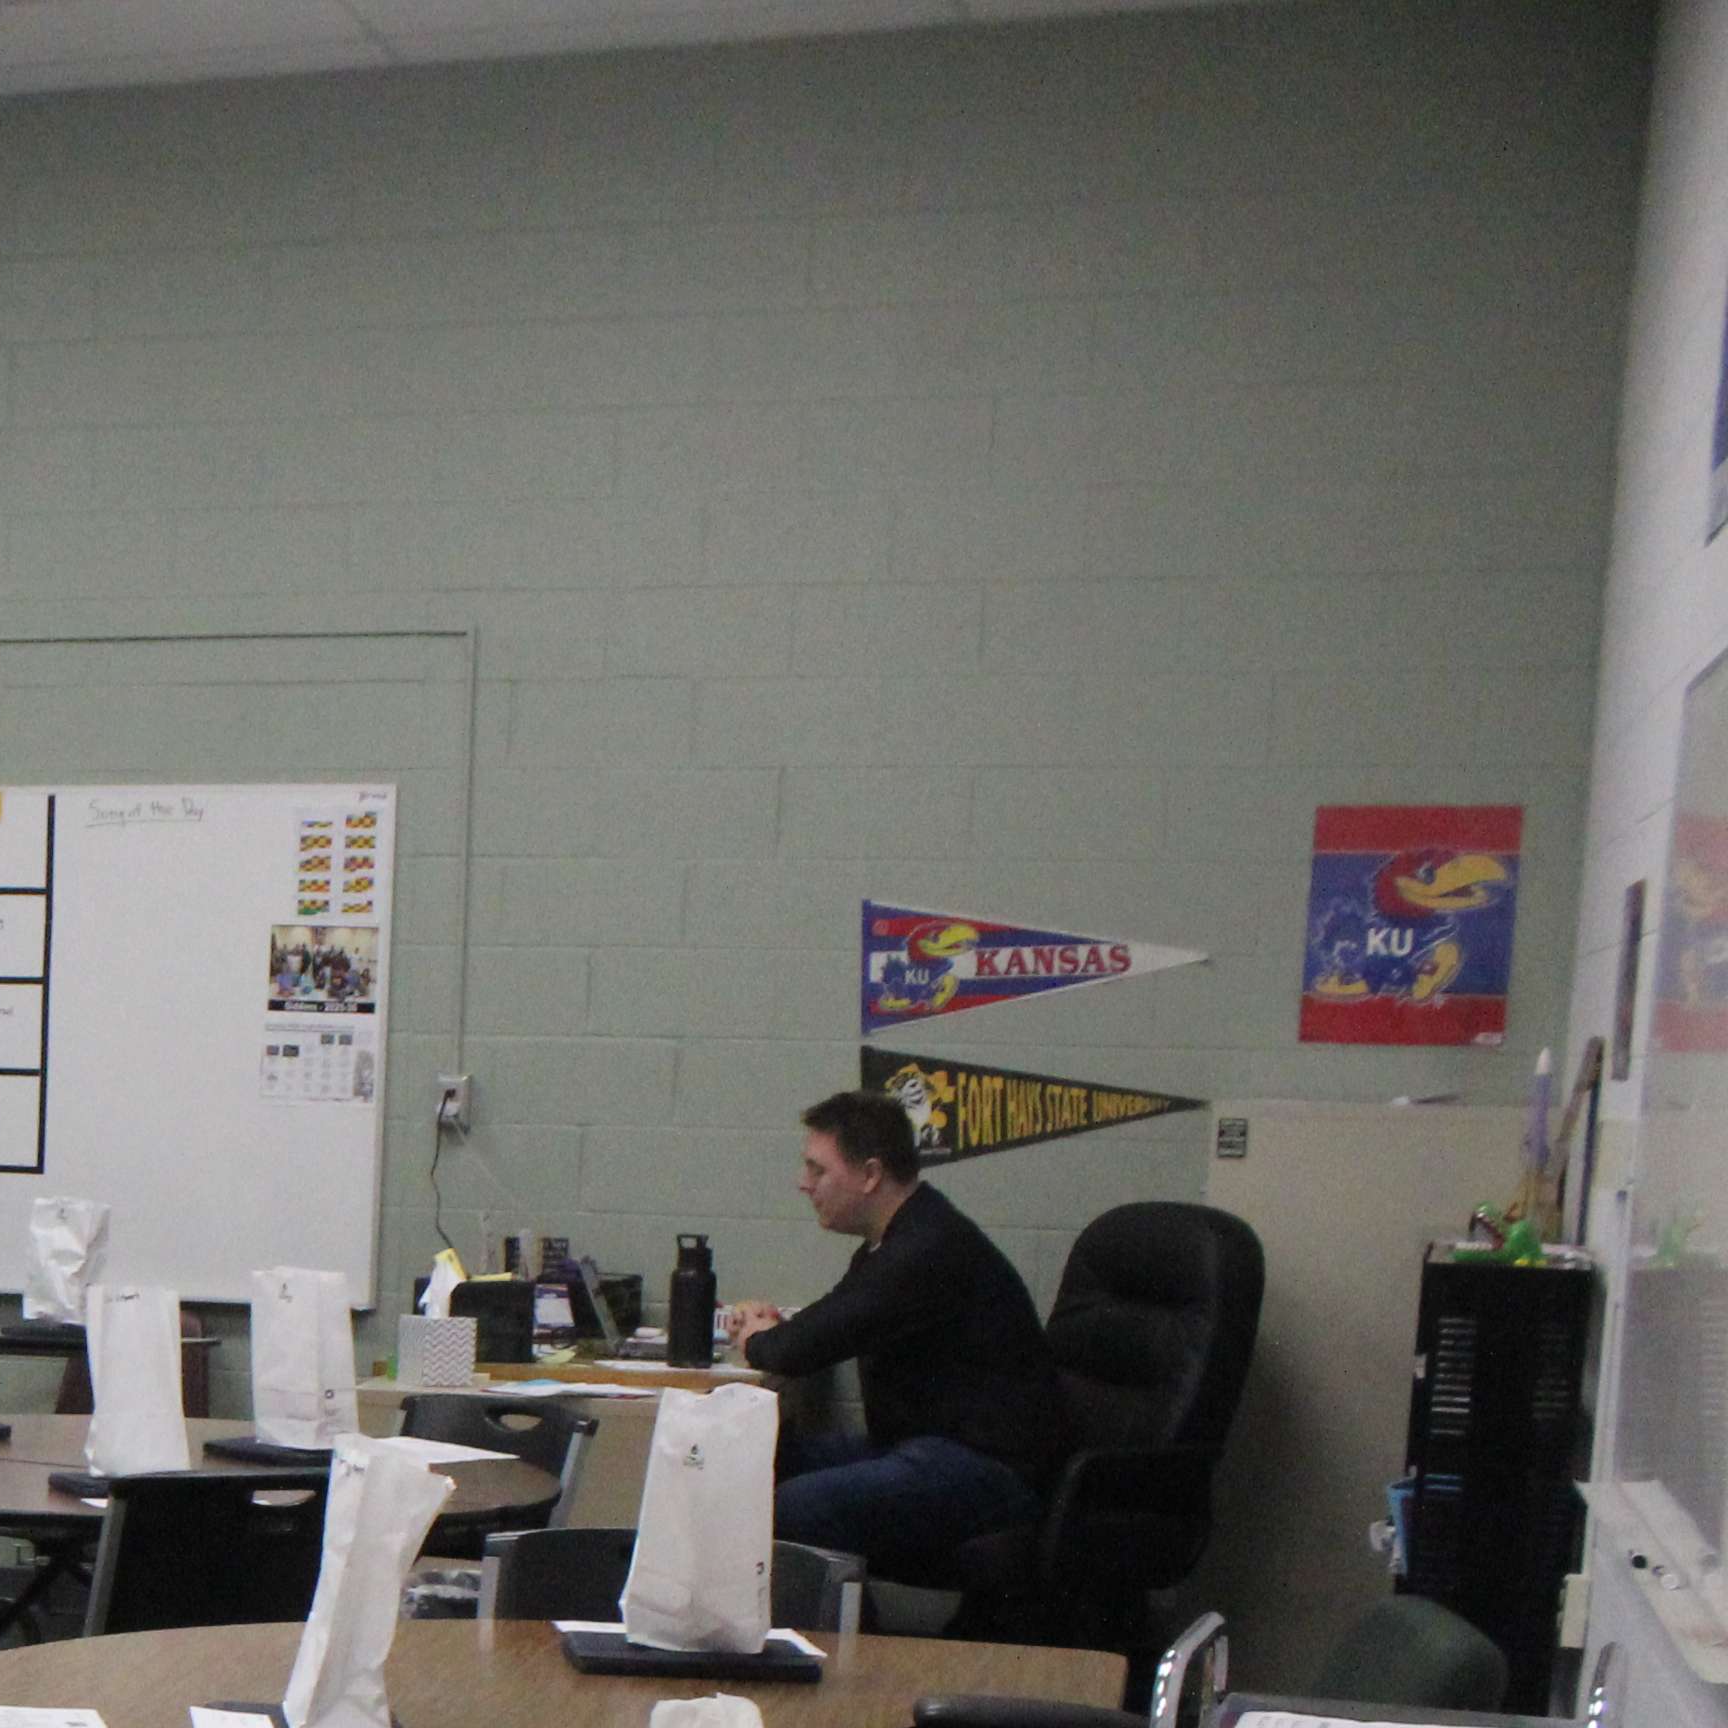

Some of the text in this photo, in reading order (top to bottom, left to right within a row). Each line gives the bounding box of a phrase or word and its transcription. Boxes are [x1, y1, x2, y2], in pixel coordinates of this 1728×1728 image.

[180, 797, 205, 822] Day
[1366, 927, 1414, 957] KU
[975, 944, 1132, 978] KANSAS
[905, 970, 930, 986] KU
[956, 1071, 1170, 1150] FORT HAYS STATE UNIVERSITY
